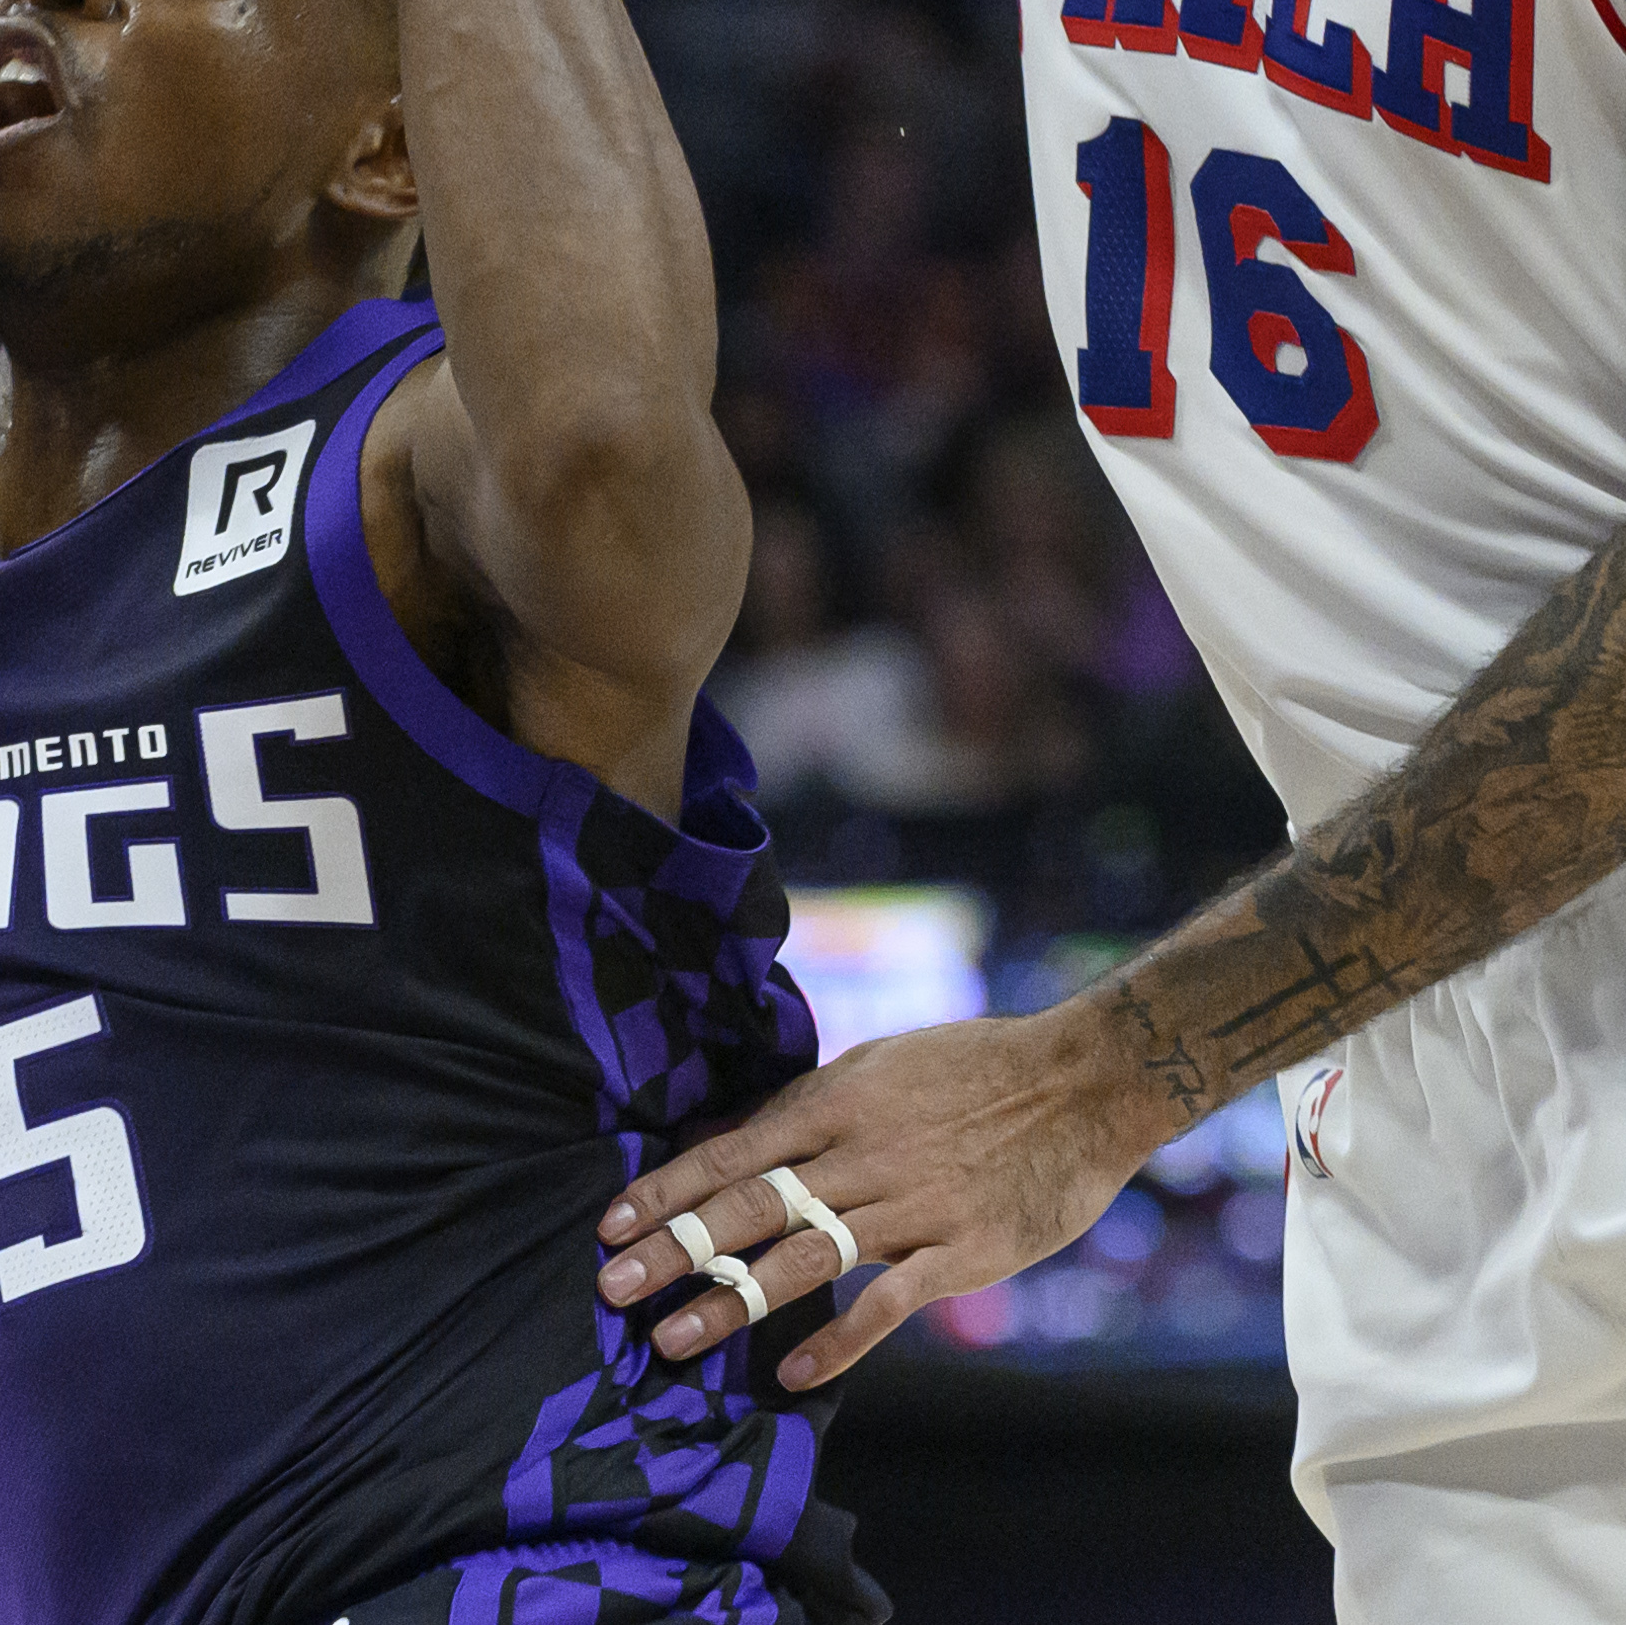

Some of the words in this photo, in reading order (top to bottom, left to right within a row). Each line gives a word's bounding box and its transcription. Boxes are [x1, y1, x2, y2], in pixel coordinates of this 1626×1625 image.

[1076, 115, 1380, 464] 16
[214, 449, 288, 536] R
[186, 528, 283, 579] REVIVER
